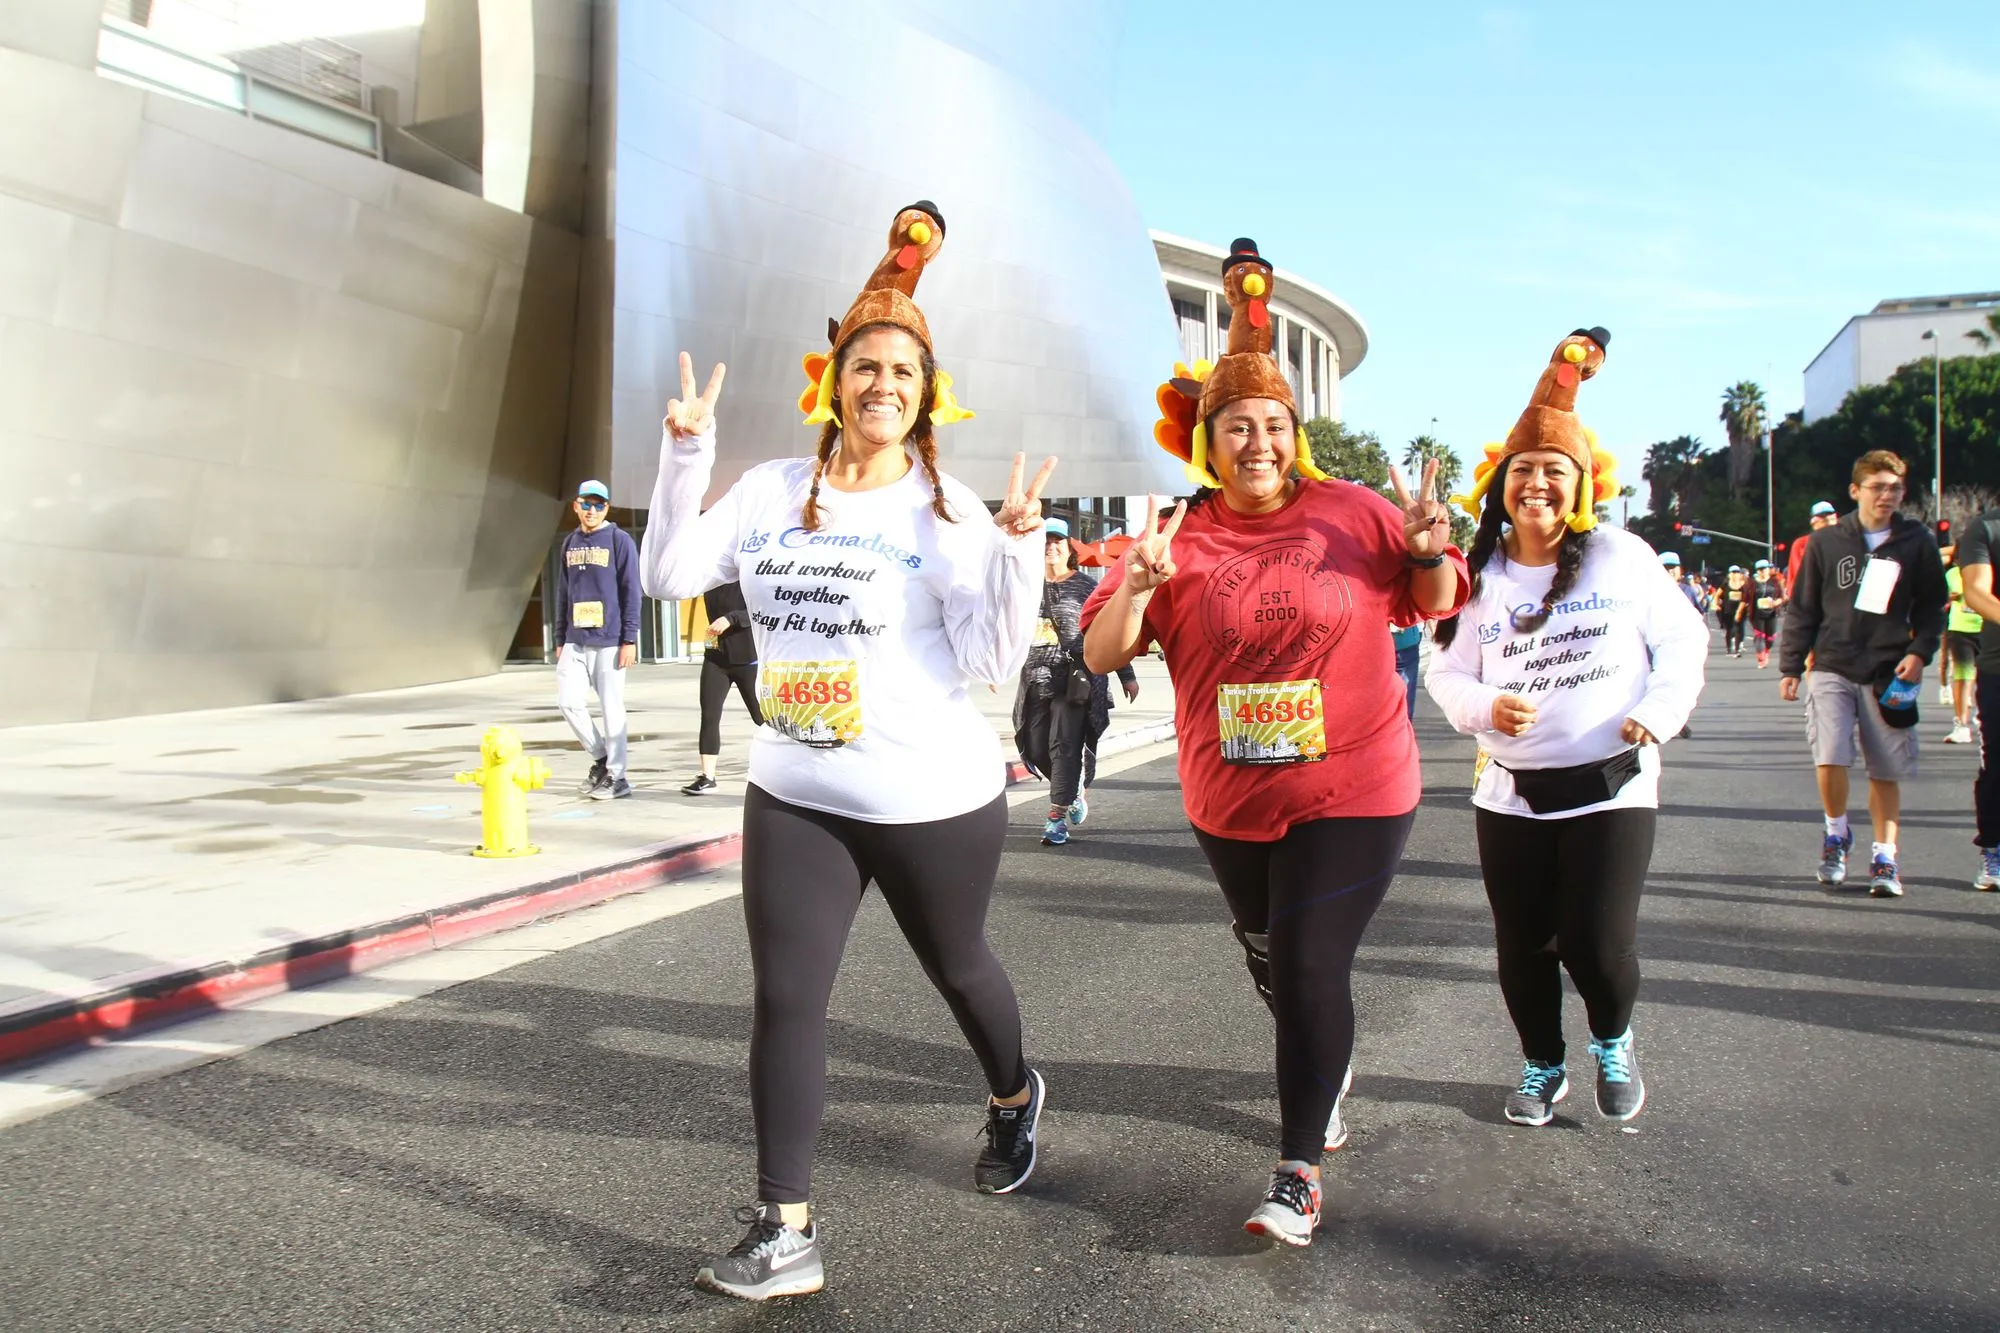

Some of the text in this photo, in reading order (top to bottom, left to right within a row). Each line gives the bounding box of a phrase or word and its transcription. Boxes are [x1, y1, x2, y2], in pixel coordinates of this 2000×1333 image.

[755, 558, 876, 582] that workout
[1218, 552, 1333, 598] THE WHISKEY
[775, 586, 850, 605] together
[1260, 591, 1291, 605] EST
[752, 610, 887, 639] stay fit together
[1255, 607, 1297, 622] 2000
[1222, 623, 1330, 661] CHICKS CLUB
[1503, 623, 1608, 658] that workout
[1524, 649, 1592, 671] together
[1528, 676, 1551, 693] fit
[1554, 665, 1620, 690] together
[776, 681, 852, 704] 4638
[1235, 699, 1316, 724] 4636
